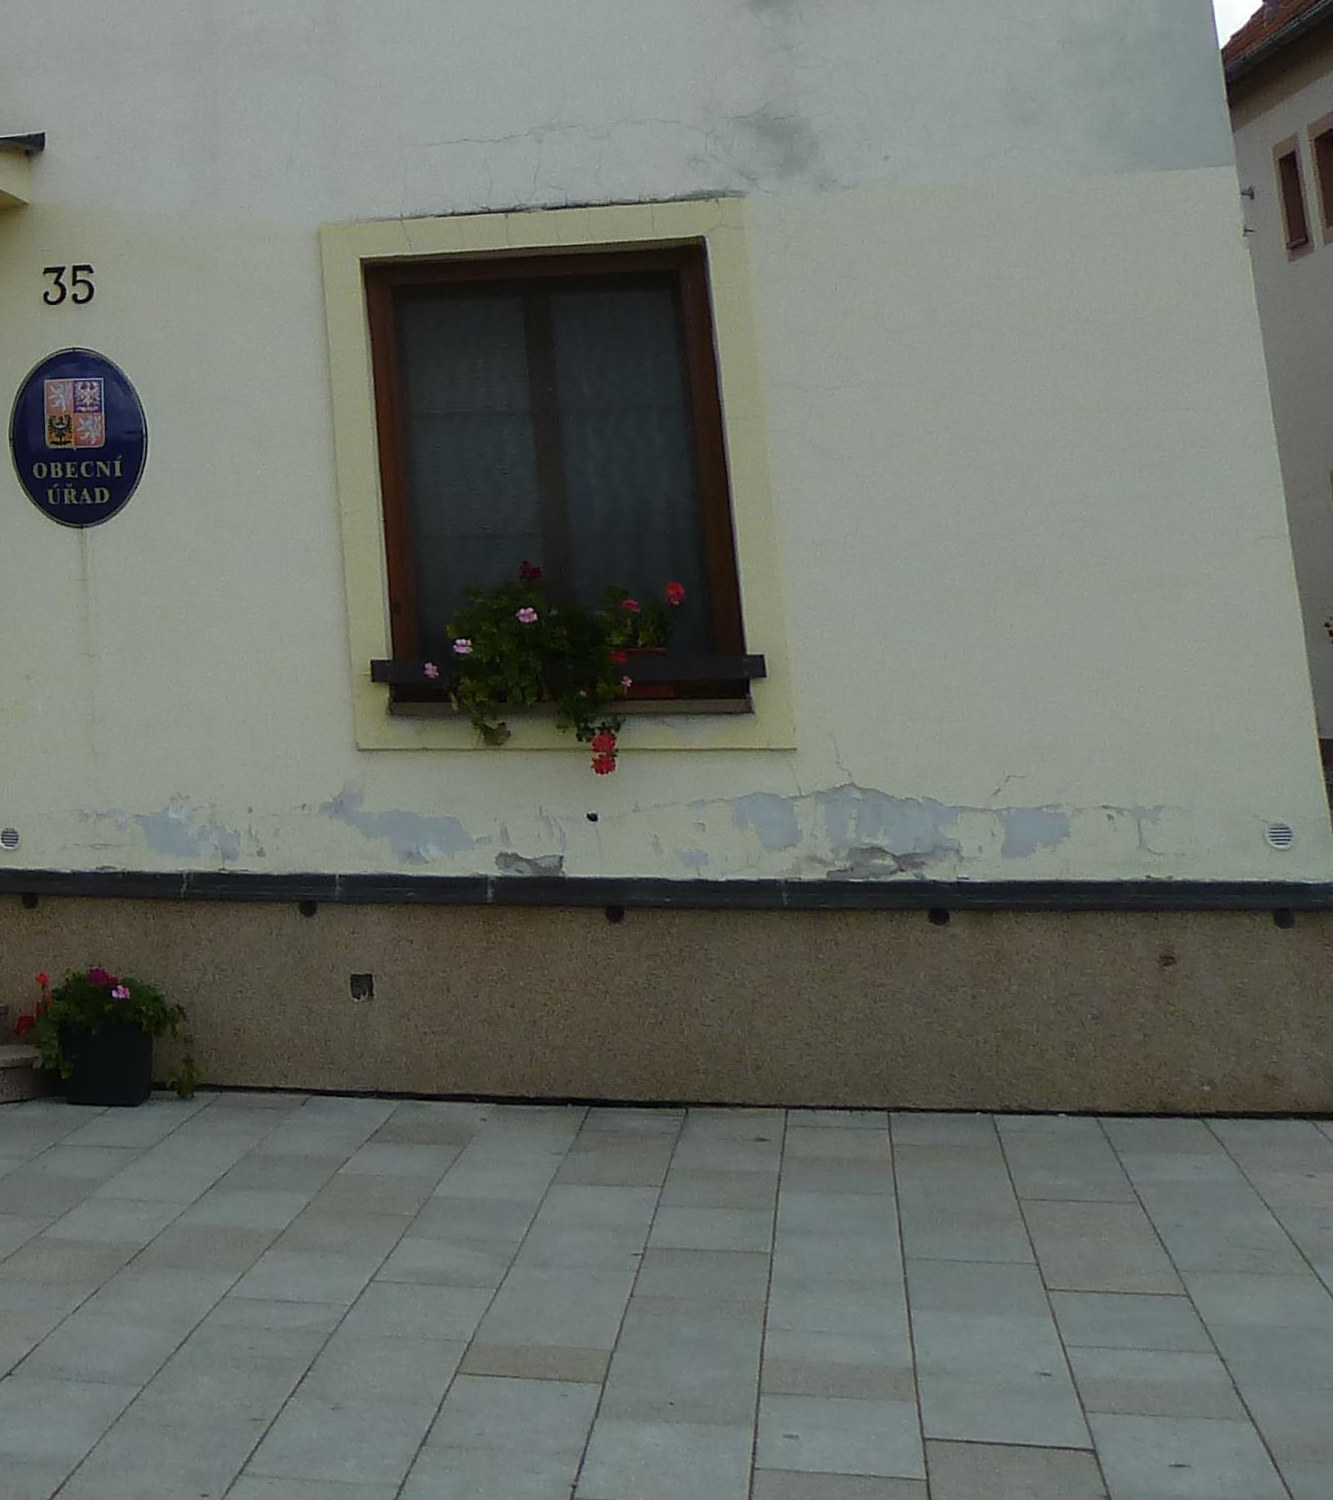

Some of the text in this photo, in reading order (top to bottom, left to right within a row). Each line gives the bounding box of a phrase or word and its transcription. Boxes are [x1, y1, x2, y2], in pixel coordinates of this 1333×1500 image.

[42, 264, 96, 305] 35
[32, 456, 124, 479] OBECNÍ
[47, 483, 111, 505] ÚŘAD
